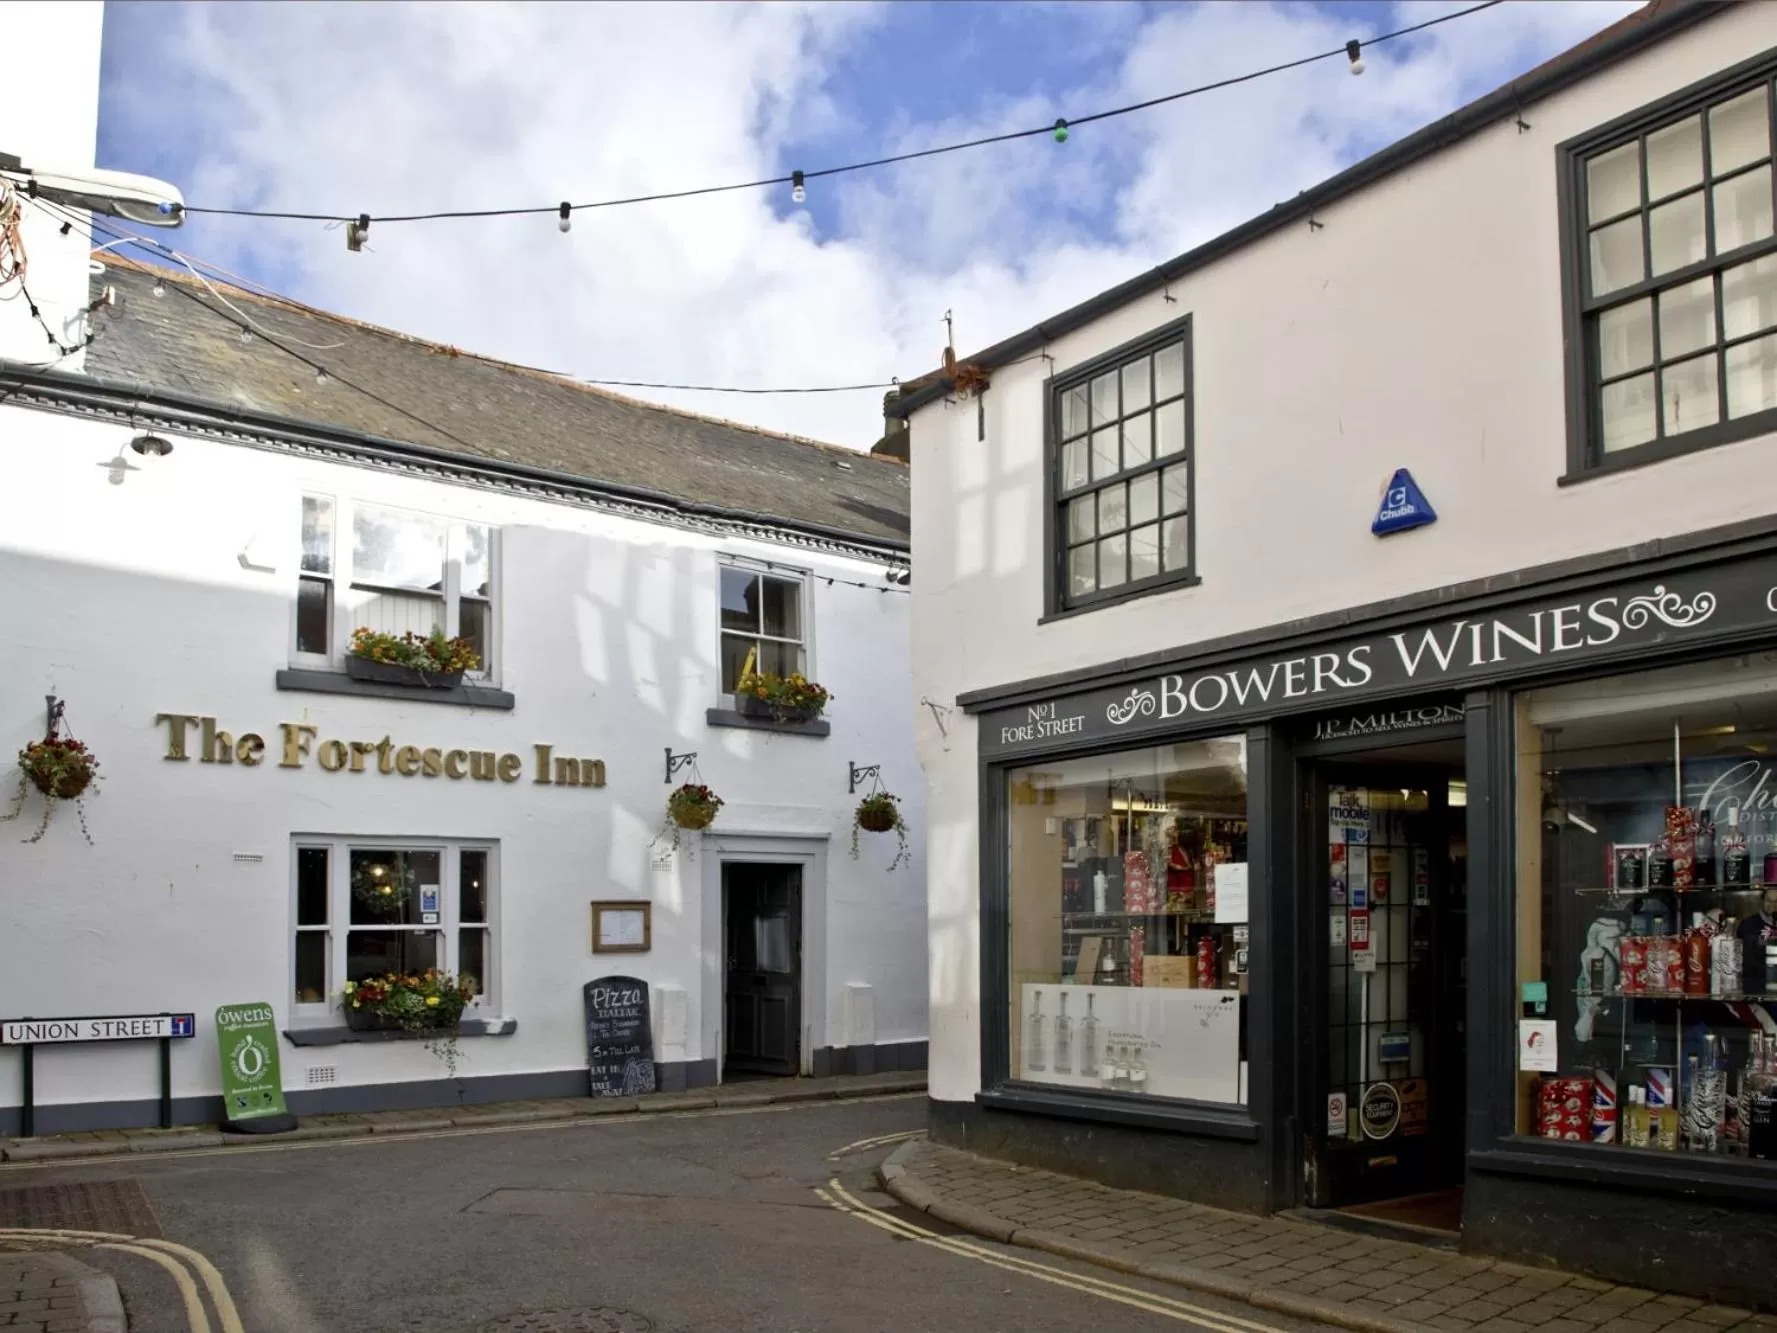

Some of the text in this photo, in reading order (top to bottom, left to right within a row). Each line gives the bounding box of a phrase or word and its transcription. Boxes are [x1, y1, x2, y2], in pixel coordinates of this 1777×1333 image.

[1158, 597, 1621, 719] BOWERS WINES
[1001, 715, 1086, 744] FORE STREET
[1350, 703, 1465, 730] MILTON
[156, 713, 606, 788] The Fortescue Inn
[590, 987, 644, 1008] Pizza
[9, 1019, 165, 1041] UNION STREET
